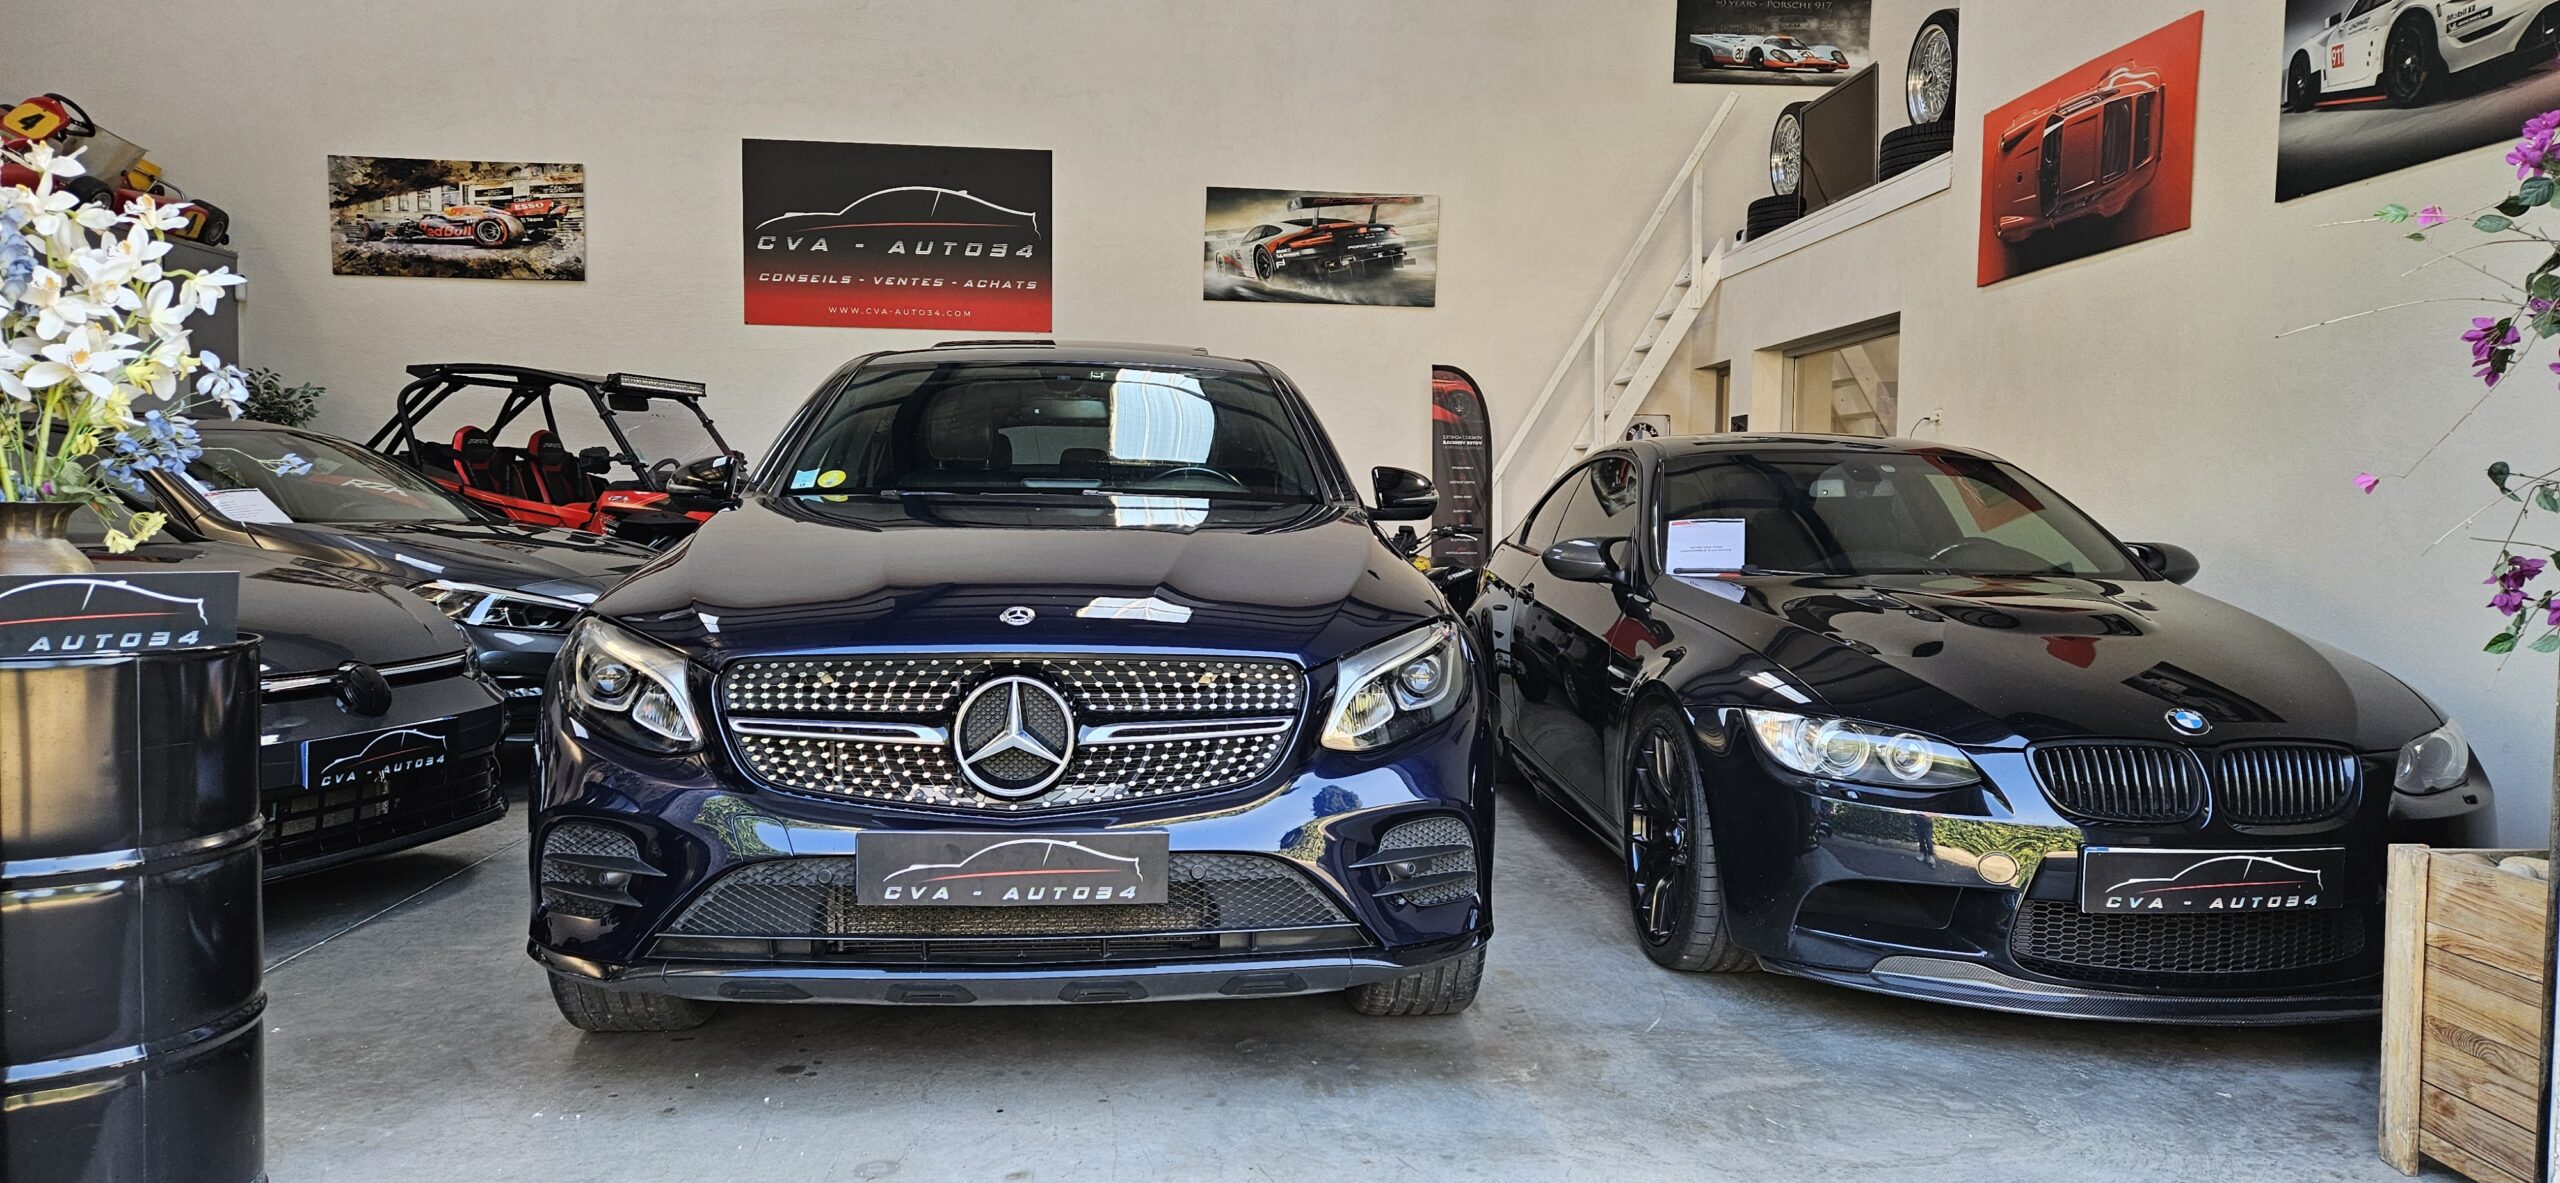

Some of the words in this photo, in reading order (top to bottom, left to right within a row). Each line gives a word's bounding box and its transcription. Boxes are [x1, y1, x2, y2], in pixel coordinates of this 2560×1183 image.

[1728, 0, 1757, 8] YEARS
[1767, 1, 1813, 9] PORSCHE
[1814, 1, 1833, 9] 917
[1735, 47, 1744, 60] 20
[2331, 45, 2344, 66] 911
[18, 112, 46, 131] 4
[514, 202, 545, 211] ESSO
[757, 236, 829, 252] CVA
[887, 240, 1034, 258] AUTO34
[759, 272, 852, 284] CONSEILS
[873, 276, 944, 287] VENTES
[963, 279, 1038, 289] ACHATS
[828, 306, 972, 318] WWW.CVA-AUTO34.COM
[28, 630, 200, 652] AUTO34
[320, 769, 356, 787] CVA
[383, 754, 446, 774] AUTO34
[884, 886, 950, 900] CVA
[1002, 884, 1137, 900] AUTO34
[2105, 896, 2164, 909] CVA
[2208, 895, 2319, 909] AUTO34
